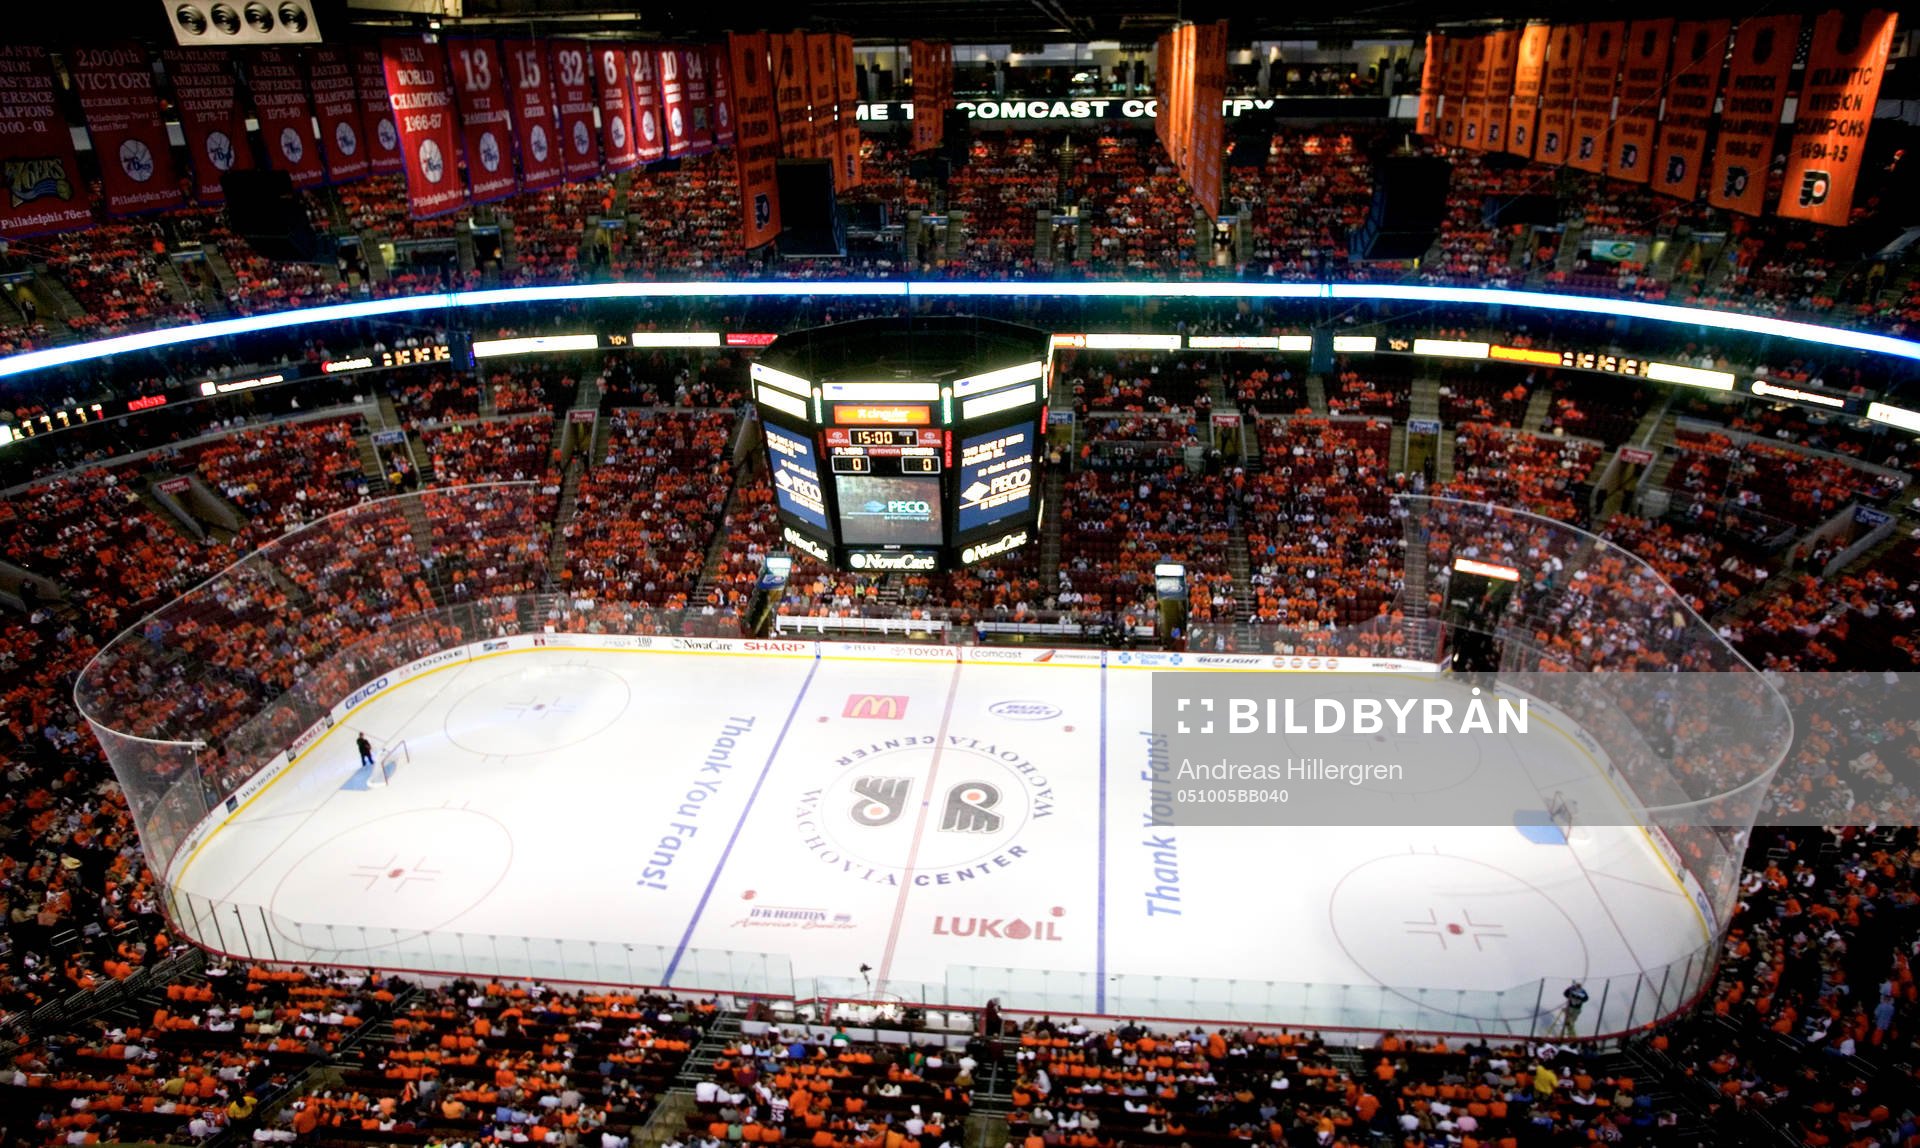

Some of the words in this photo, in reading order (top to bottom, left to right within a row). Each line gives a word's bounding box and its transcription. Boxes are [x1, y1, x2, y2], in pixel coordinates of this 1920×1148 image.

[76, 50, 140, 68] 2,000th
[460, 48, 491, 92] 13
[515, 50, 541, 89] 15
[559, 50, 585, 86] 32
[604, 51, 617, 85] 6
[632, 50, 652, 82] 24
[661, 52, 678, 81] 10
[74, 73, 152, 90] VICTORY
[397, 69, 435, 86] WORLD
[1809, 68, 1873, 86] ATLANTIC
[390, 91, 450, 110] CHAMPIONS
[956, 101, 1109, 119] COMCAST
[404, 114, 442, 133] 1966-67
[1, 212, 62, 229] Philadelphia
[857, 431, 893, 445] 15:00
[853, 458, 862, 471] 0
[923, 458, 933, 471] 0
[990, 468, 1032, 495] PECO
[887, 500, 930, 514] PECO
[973, 531, 1028, 561] NovaCare
[864, 553, 935, 570] NovaCare
[683, 638, 734, 651] NovaCare
[743, 641, 806, 653] SHARP
[908, 647, 954, 657] TOYOTA
[973, 648, 1022, 660] comcast
[412, 650, 464, 672] DODGE
[344, 677, 389, 711] GEICO
[700, 716, 756, 774] Thank
[835, 735, 935, 767] CENTER
[1139, 731, 1172, 784] Fans!
[948, 736, 1055, 820] WACHOVIA
[676, 781, 723, 817] You
[1143, 789, 1175, 829] You
[796, 788, 898, 887] WACHOVIA
[914, 845, 1028, 886] CENTER
[636, 823, 698, 890] Fans!
[1142, 835, 1182, 917] Thank
[933, 916, 1063, 941] LUKOIL
